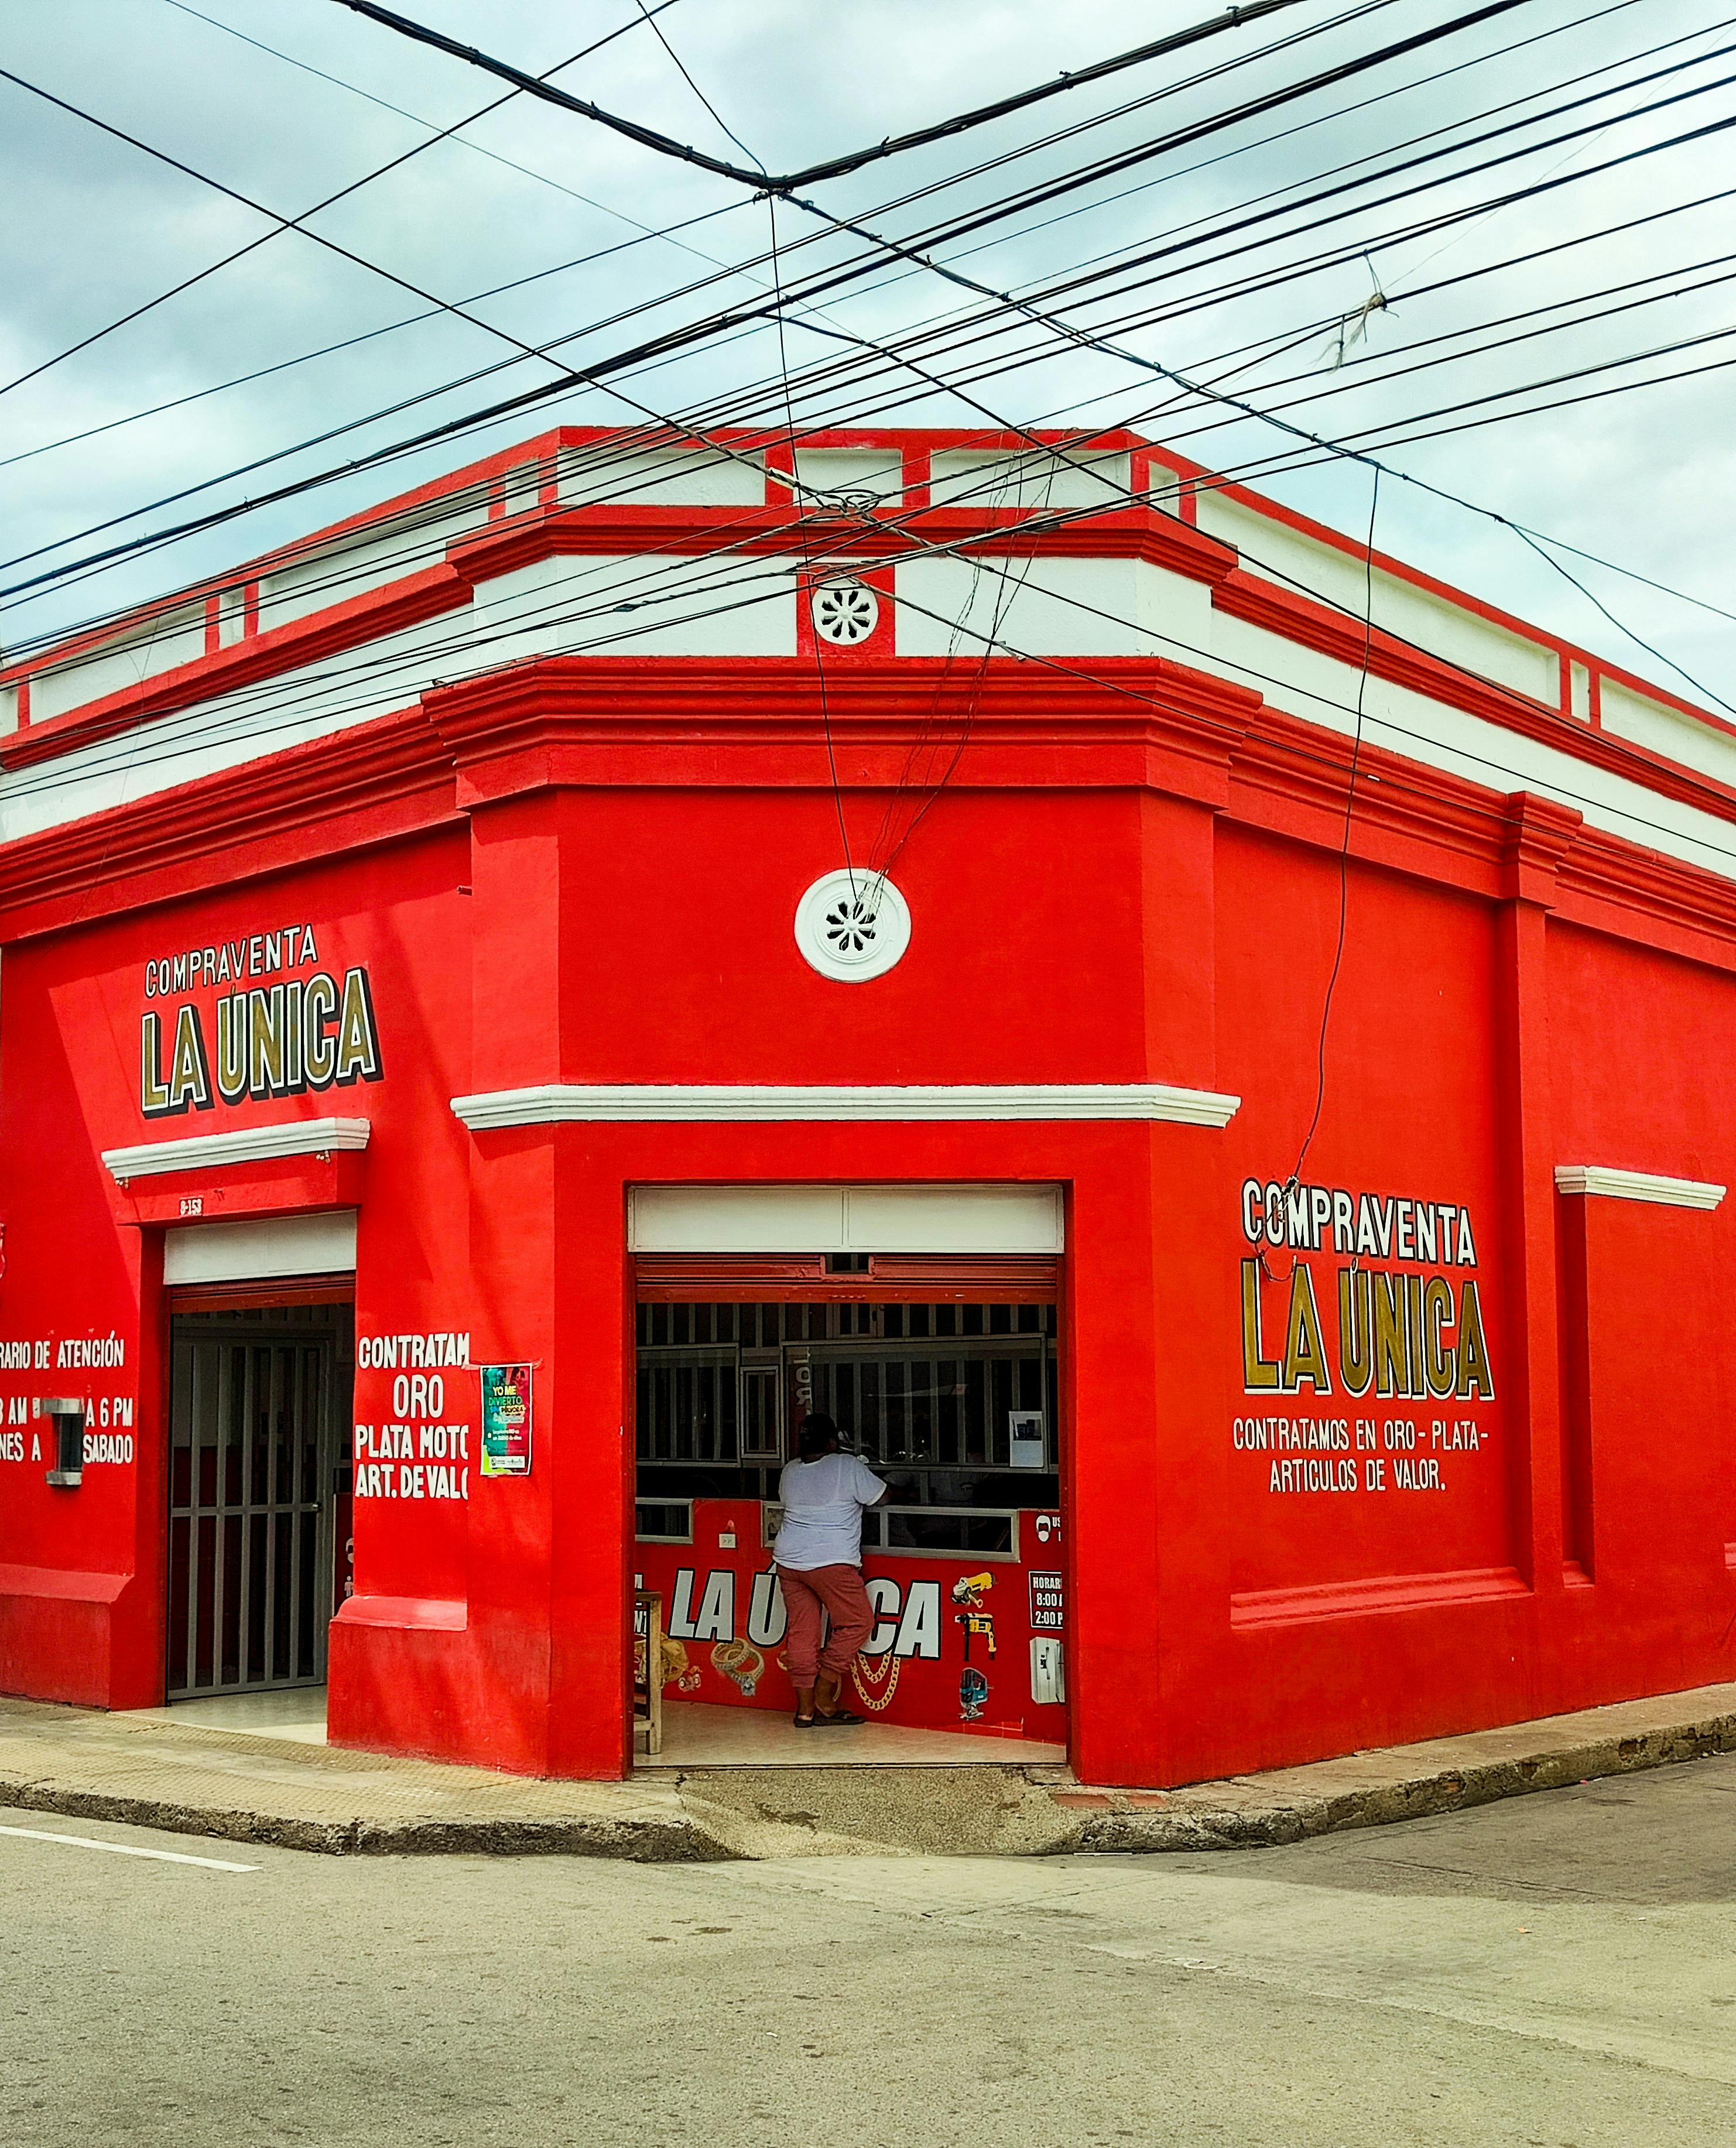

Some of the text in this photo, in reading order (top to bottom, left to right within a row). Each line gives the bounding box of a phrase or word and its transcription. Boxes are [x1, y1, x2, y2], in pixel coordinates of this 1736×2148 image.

[145, 924, 318, 997] COMPRAVENTA
[142, 1005, 214, 1119] LA
[1242, 1178, 1477, 1267] COMPRAVENTA
[1241, 1257, 1333, 1395] LA
[35, 1341, 50, 1369] DE
[57, 1330, 124, 1369] ATENCIÓN
[393, 1375, 443, 1419] ORO
[493, 1385, 516, 1396] YO ME
[8, 1397, 27, 1424] AM
[85, 1397, 95, 1427] A
[100, 1397, 109, 1427] 6
[113, 1397, 133, 1426] PM
[31, 1433, 41, 1461] A
[83, 1434, 133, 1464] SABADO
[355, 1425, 413, 1459] PLATA
[1234, 1417, 1349, 1450] CONTRATAMOS
[1356, 1419, 1377, 1451] EN
[355, 1464, 397, 1499] ART.
[400, 1465, 425, 1499] DE
[1270, 1459, 1446, 1492] ARTICULOS DE VALOR.
[669, 1567, 736, 1643] LA
[1036, 1592, 1057, 1606] 8:00
[1035, 1611, 1056, 1625] 2:00
